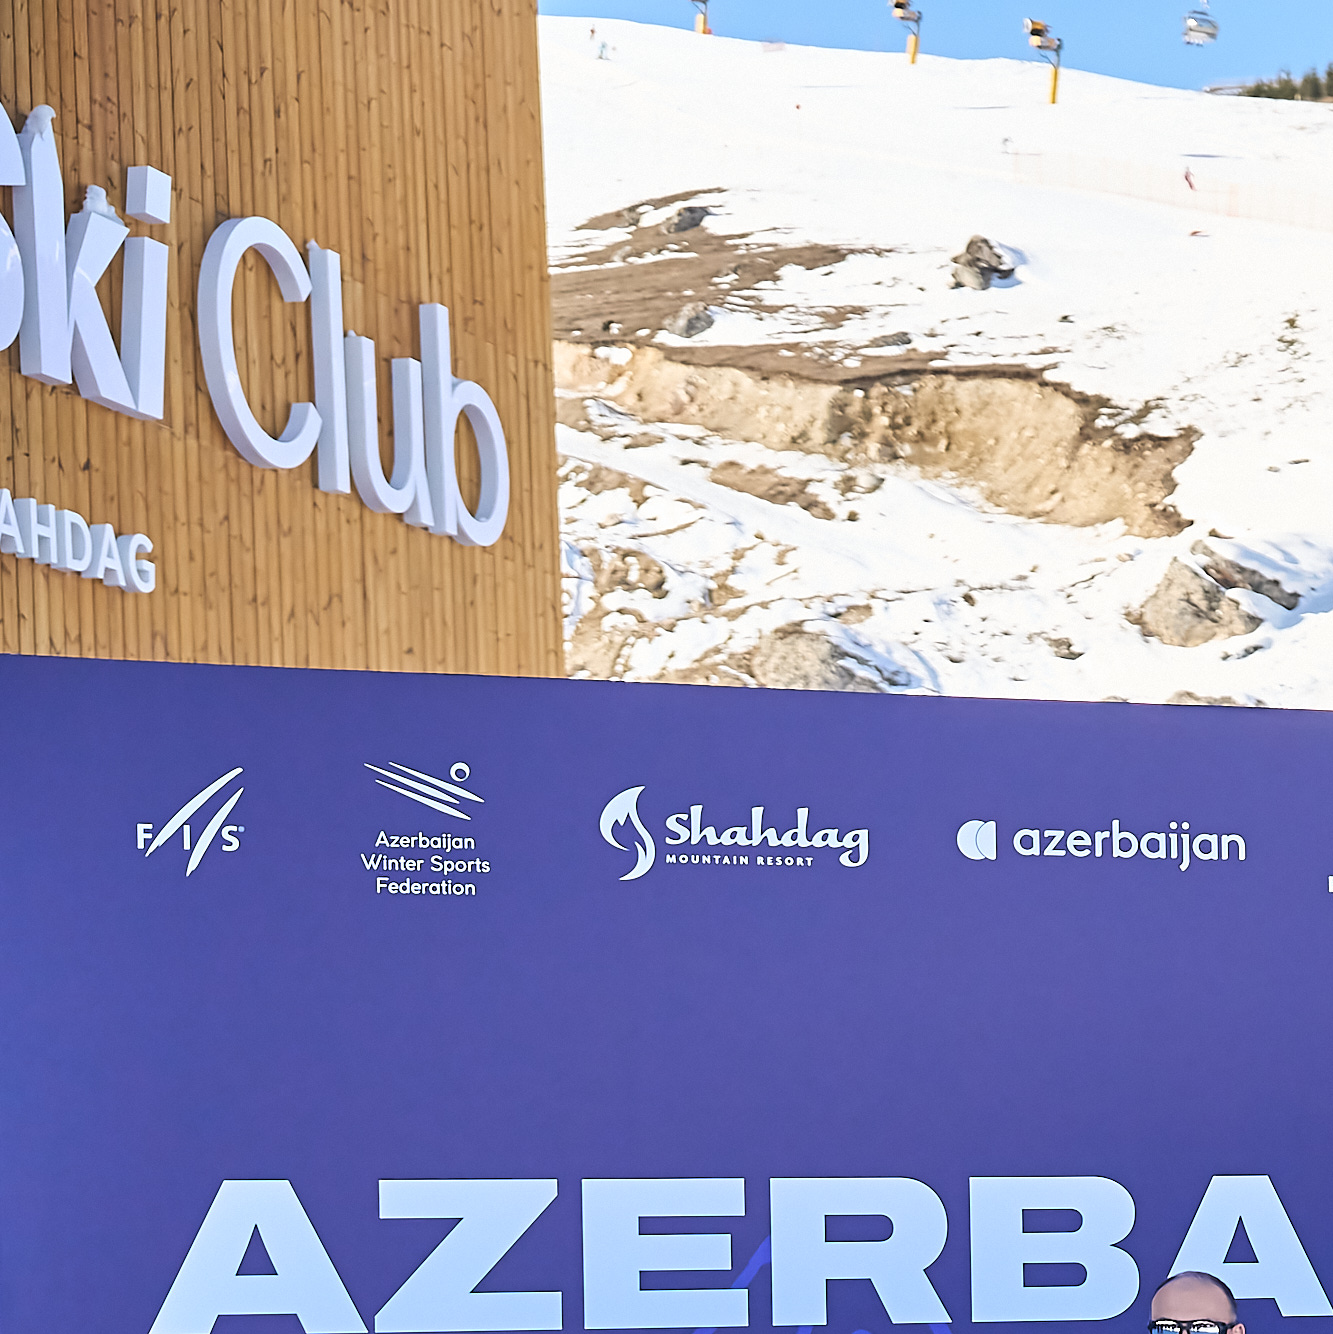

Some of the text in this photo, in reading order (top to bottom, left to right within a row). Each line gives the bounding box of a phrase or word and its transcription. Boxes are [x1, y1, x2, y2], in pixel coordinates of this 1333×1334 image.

[197, 216, 511, 547] Club
[374, 830, 475, 853] Azerbaijan
[664, 803, 870, 868] Shahdag
[1013, 819, 1246, 872] azerbaijan
[360, 853, 491, 876] Winter Sports
[665, 854, 814, 867] MOUNTAIN RESORT
[376, 876, 476, 896] Federation
